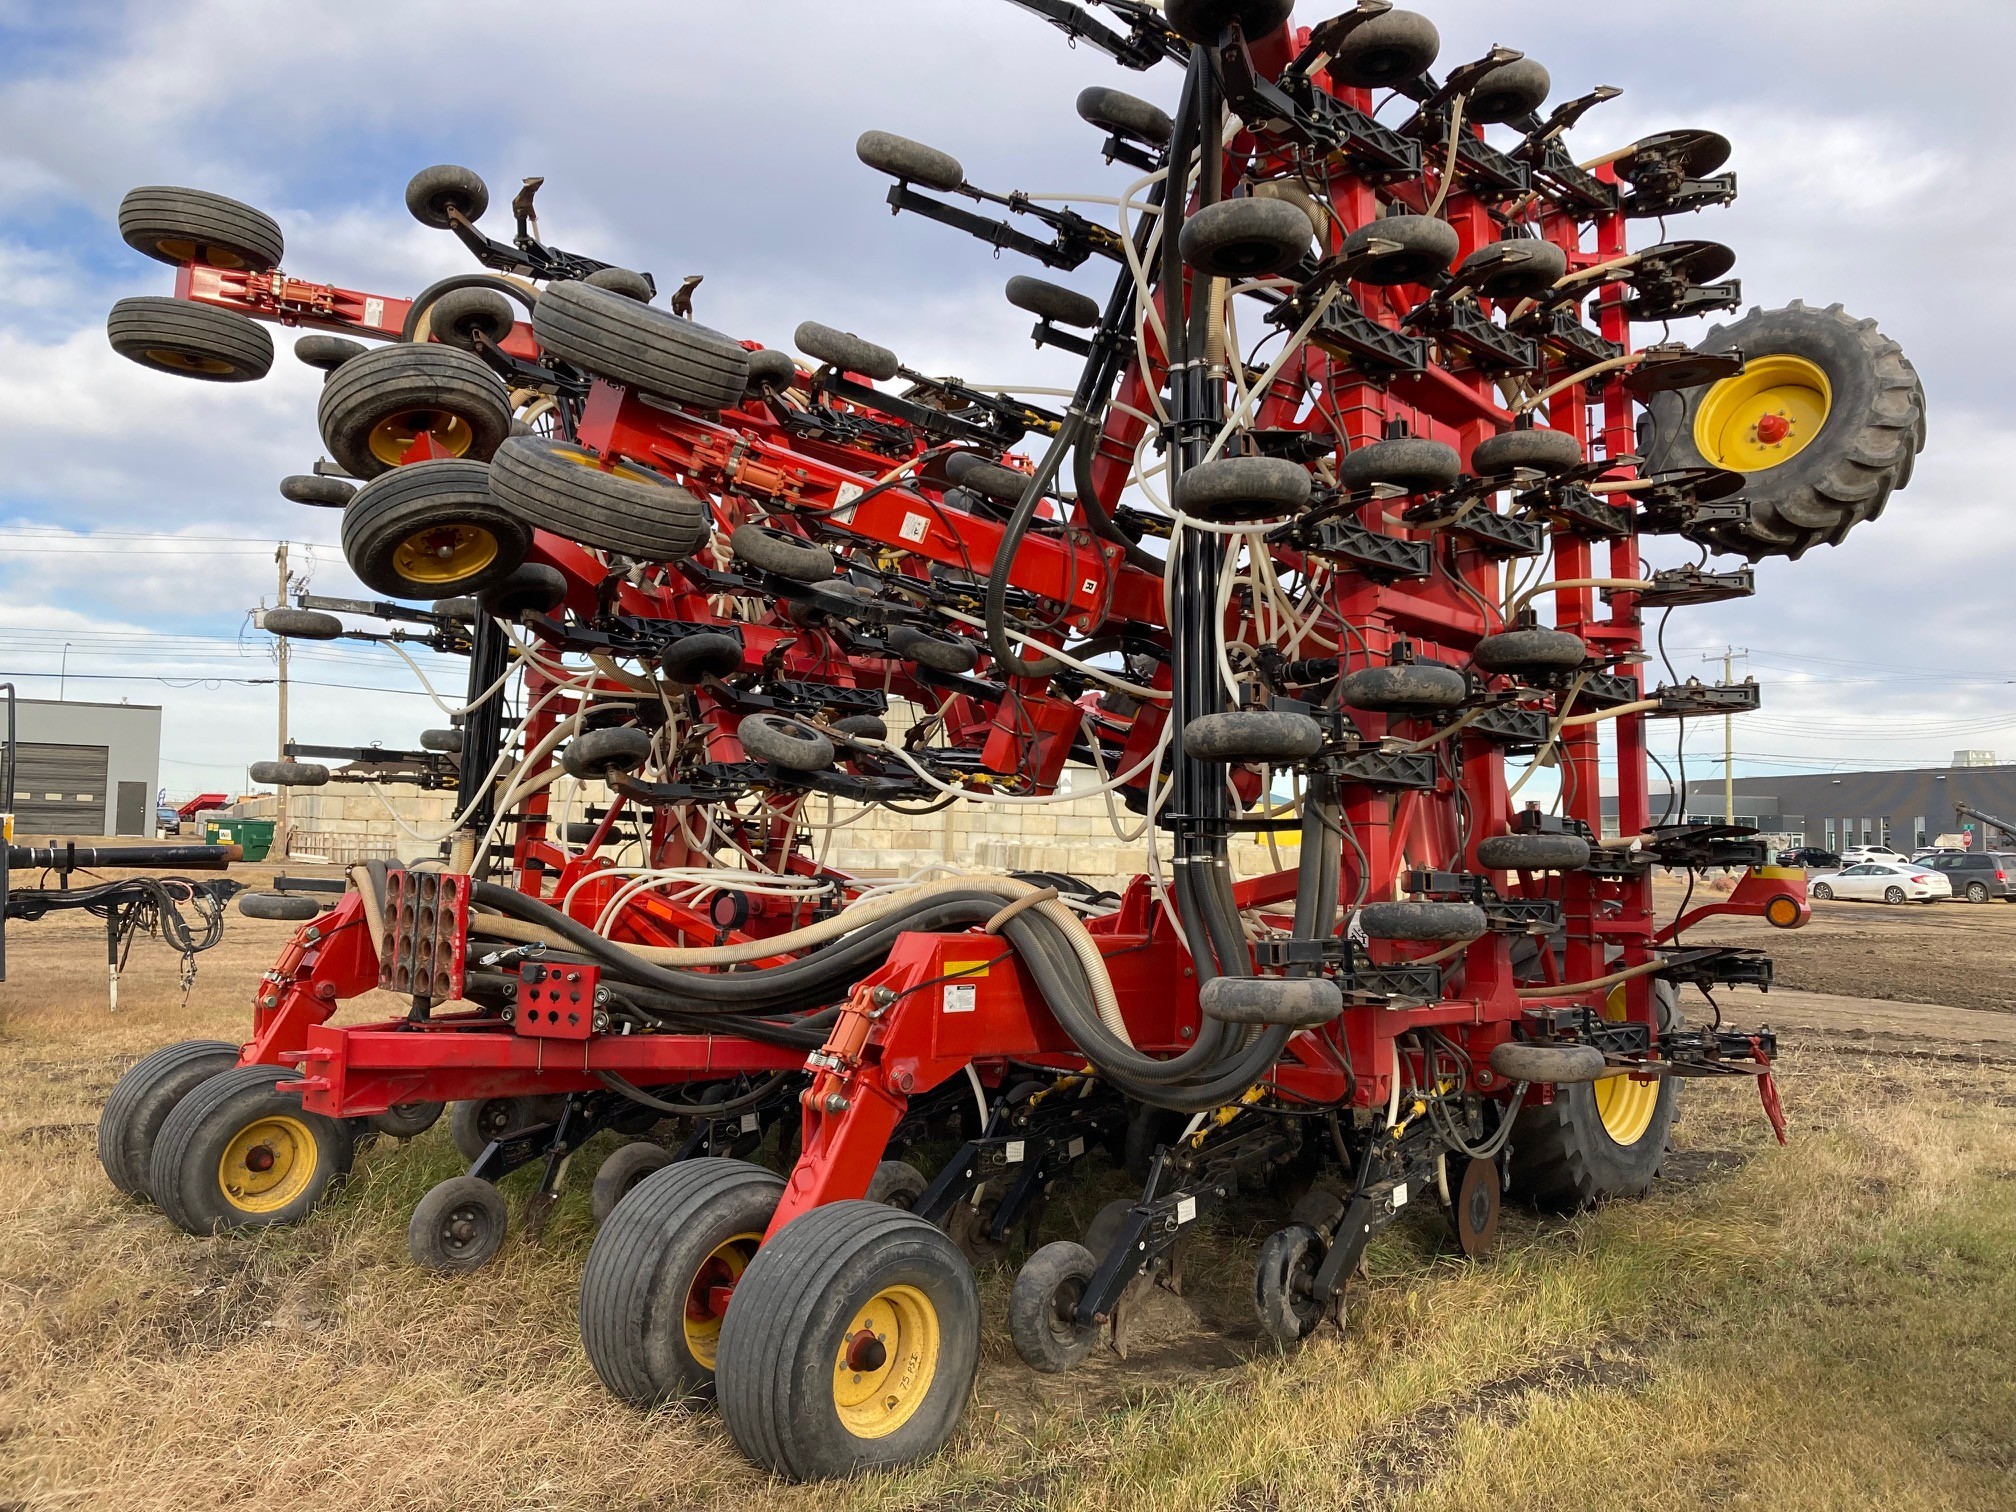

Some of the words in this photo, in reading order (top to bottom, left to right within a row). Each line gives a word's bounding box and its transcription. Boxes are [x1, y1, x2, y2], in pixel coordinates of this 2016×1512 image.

[1085, 581, 1095, 591] R
[899, 1375, 910, 1390] 75
[907, 1352, 918, 1374] PSI
